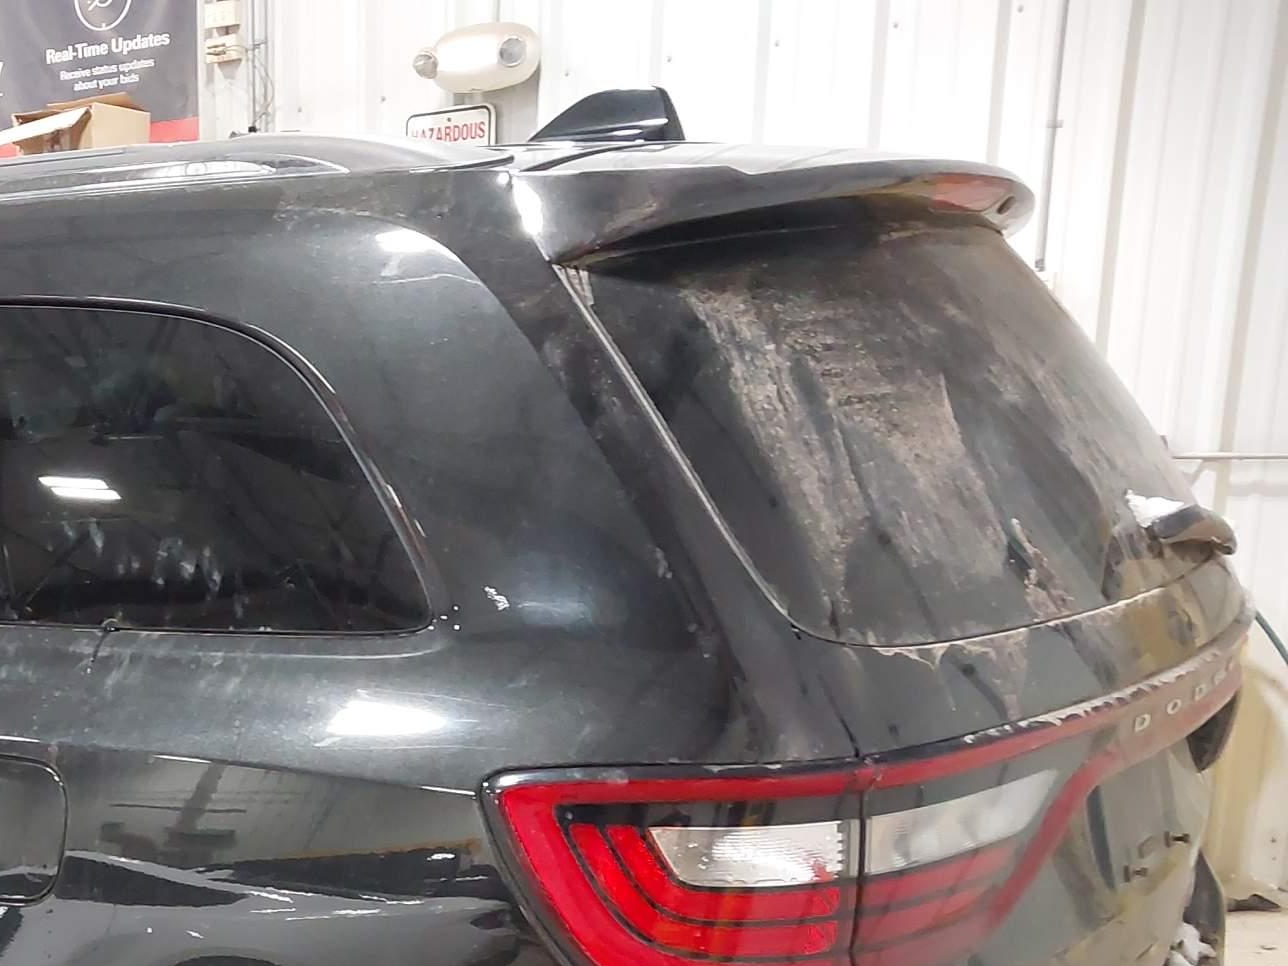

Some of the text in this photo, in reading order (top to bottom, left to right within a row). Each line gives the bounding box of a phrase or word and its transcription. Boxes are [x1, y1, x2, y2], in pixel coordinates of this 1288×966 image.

[45, 33, 170, 65] Real-Time Updates
[59, 59, 155, 80] Receive status updates
[73, 73, 140, 91] about your bids
[412, 121, 486, 141] HAZARDOUS
